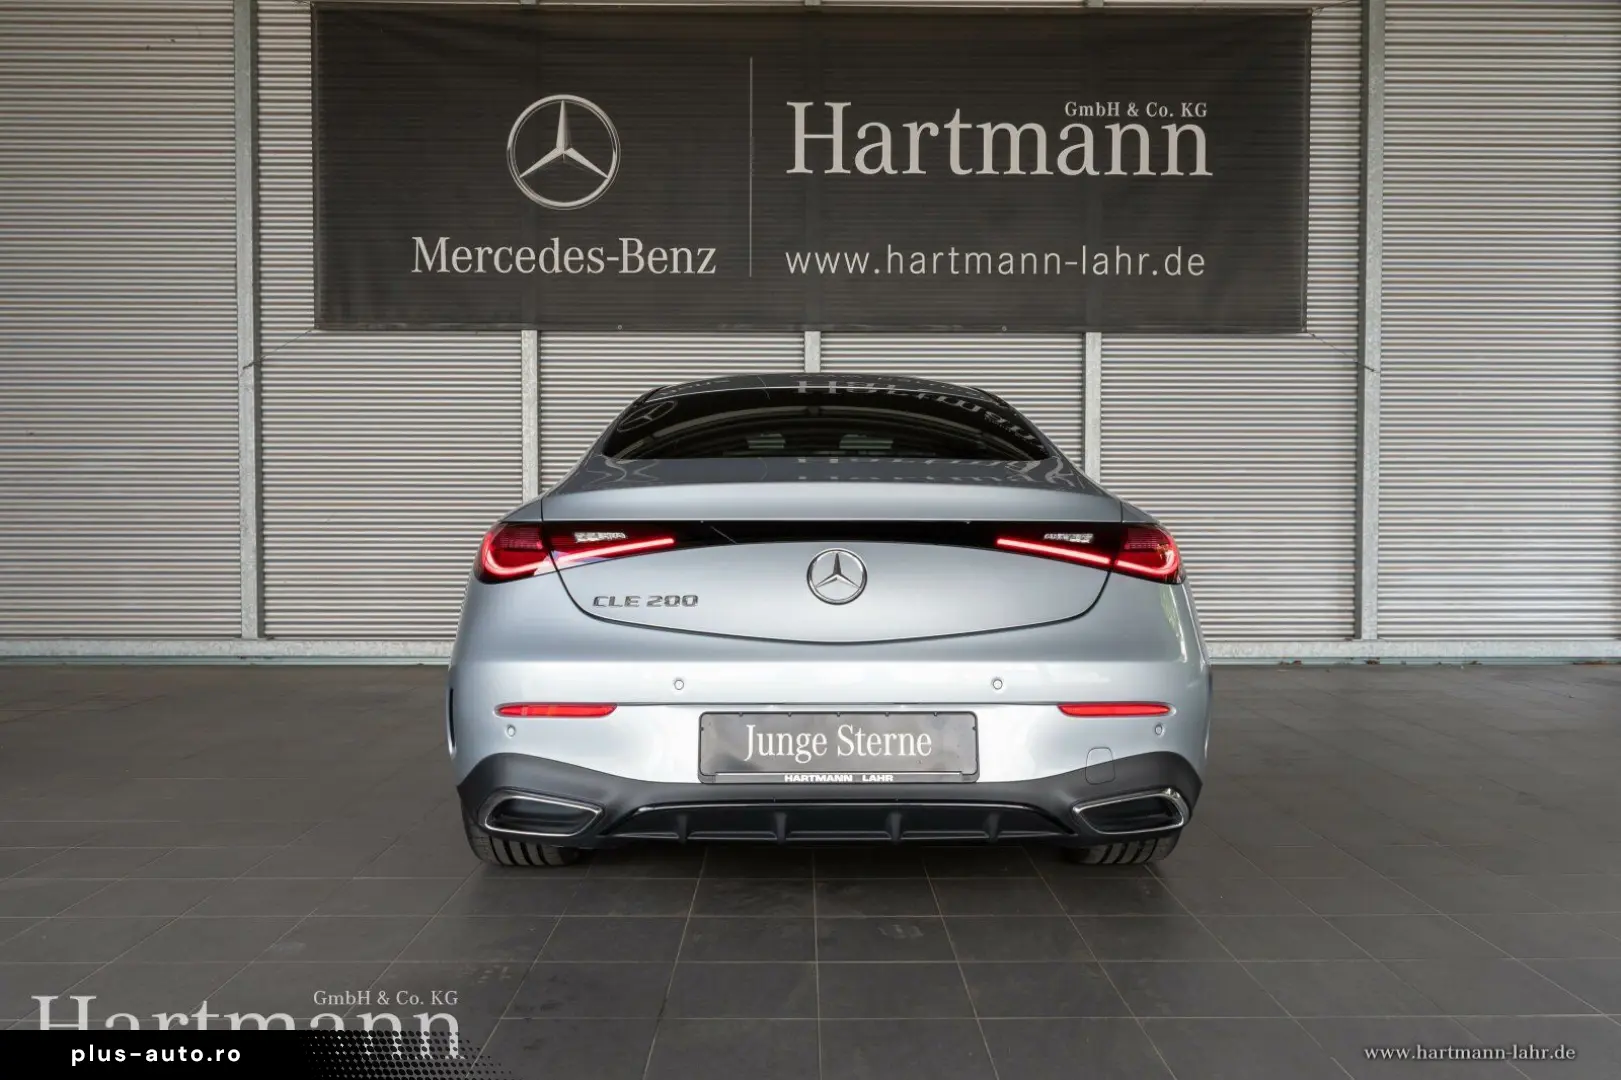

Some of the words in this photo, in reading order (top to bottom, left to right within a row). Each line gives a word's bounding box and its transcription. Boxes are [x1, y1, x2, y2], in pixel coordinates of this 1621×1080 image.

[1064, 101, 1120, 117] GmbH
[1126, 101, 1140, 118] &
[1145, 101, 1175, 118] Co.
[1180, 101, 1208, 118] KG
[786, 101, 1213, 176] Hartmann
[411, 236, 717, 275] Mercedes-Benz
[785, 243, 1206, 277] www.hartmann-lahr.de
[592, 595, 641, 608] CLE
[646, 595, 699, 608] 200
[743, 724, 828, 764] Junge
[837, 724, 933, 757] Sterne
[784, 774, 853, 783] HARTMANN
[861, 774, 894, 783] LAHR
